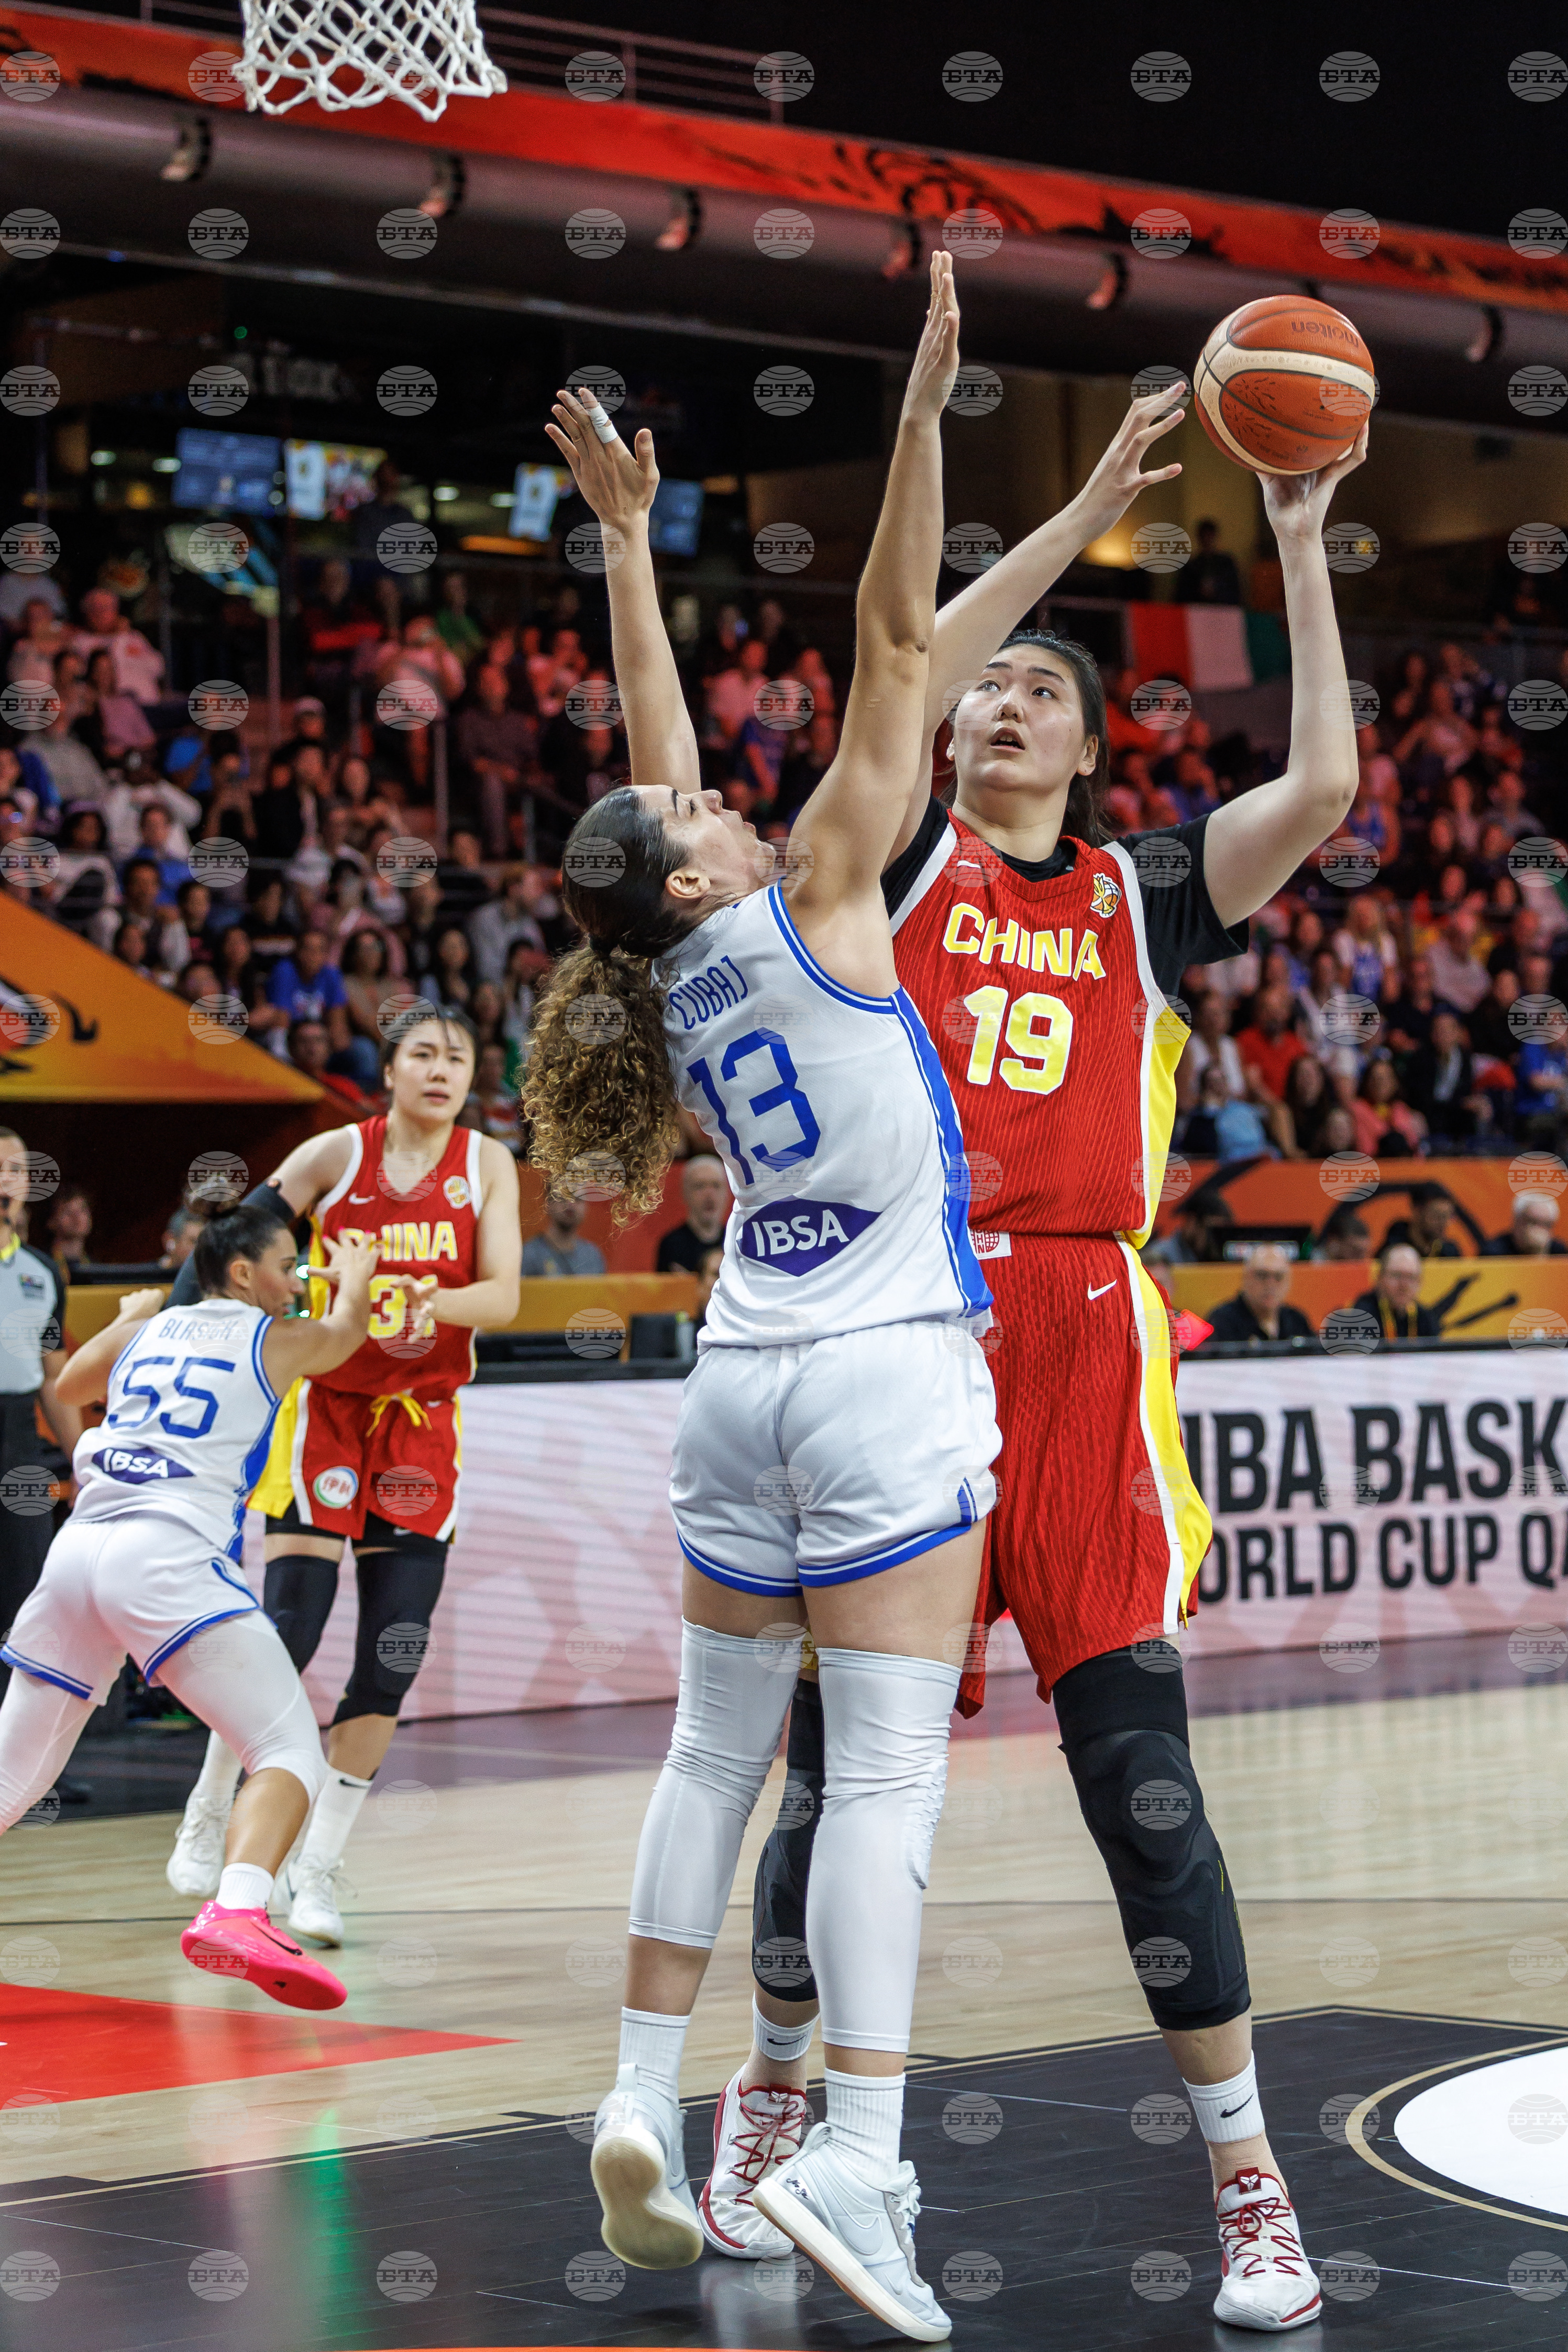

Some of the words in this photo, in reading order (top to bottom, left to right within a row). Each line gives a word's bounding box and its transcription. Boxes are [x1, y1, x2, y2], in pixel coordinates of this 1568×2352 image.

[1291, 321, 1359, 348] molten
[943, 902, 1106, 981] CHINA
[668, 955, 748, 1031] CUBAJ
[963, 985, 1074, 1095] 19
[686, 1026, 821, 1186] 13
[751, 1208, 849, 1257] IBSA
[108, 1356, 236, 1439] 55
[103, 1448, 169, 1479] IBSA
[1349, 1395, 1568, 1505] BASK
[1378, 1513, 1501, 1589] CUP
[1520, 1510, 1568, 1589] Q
